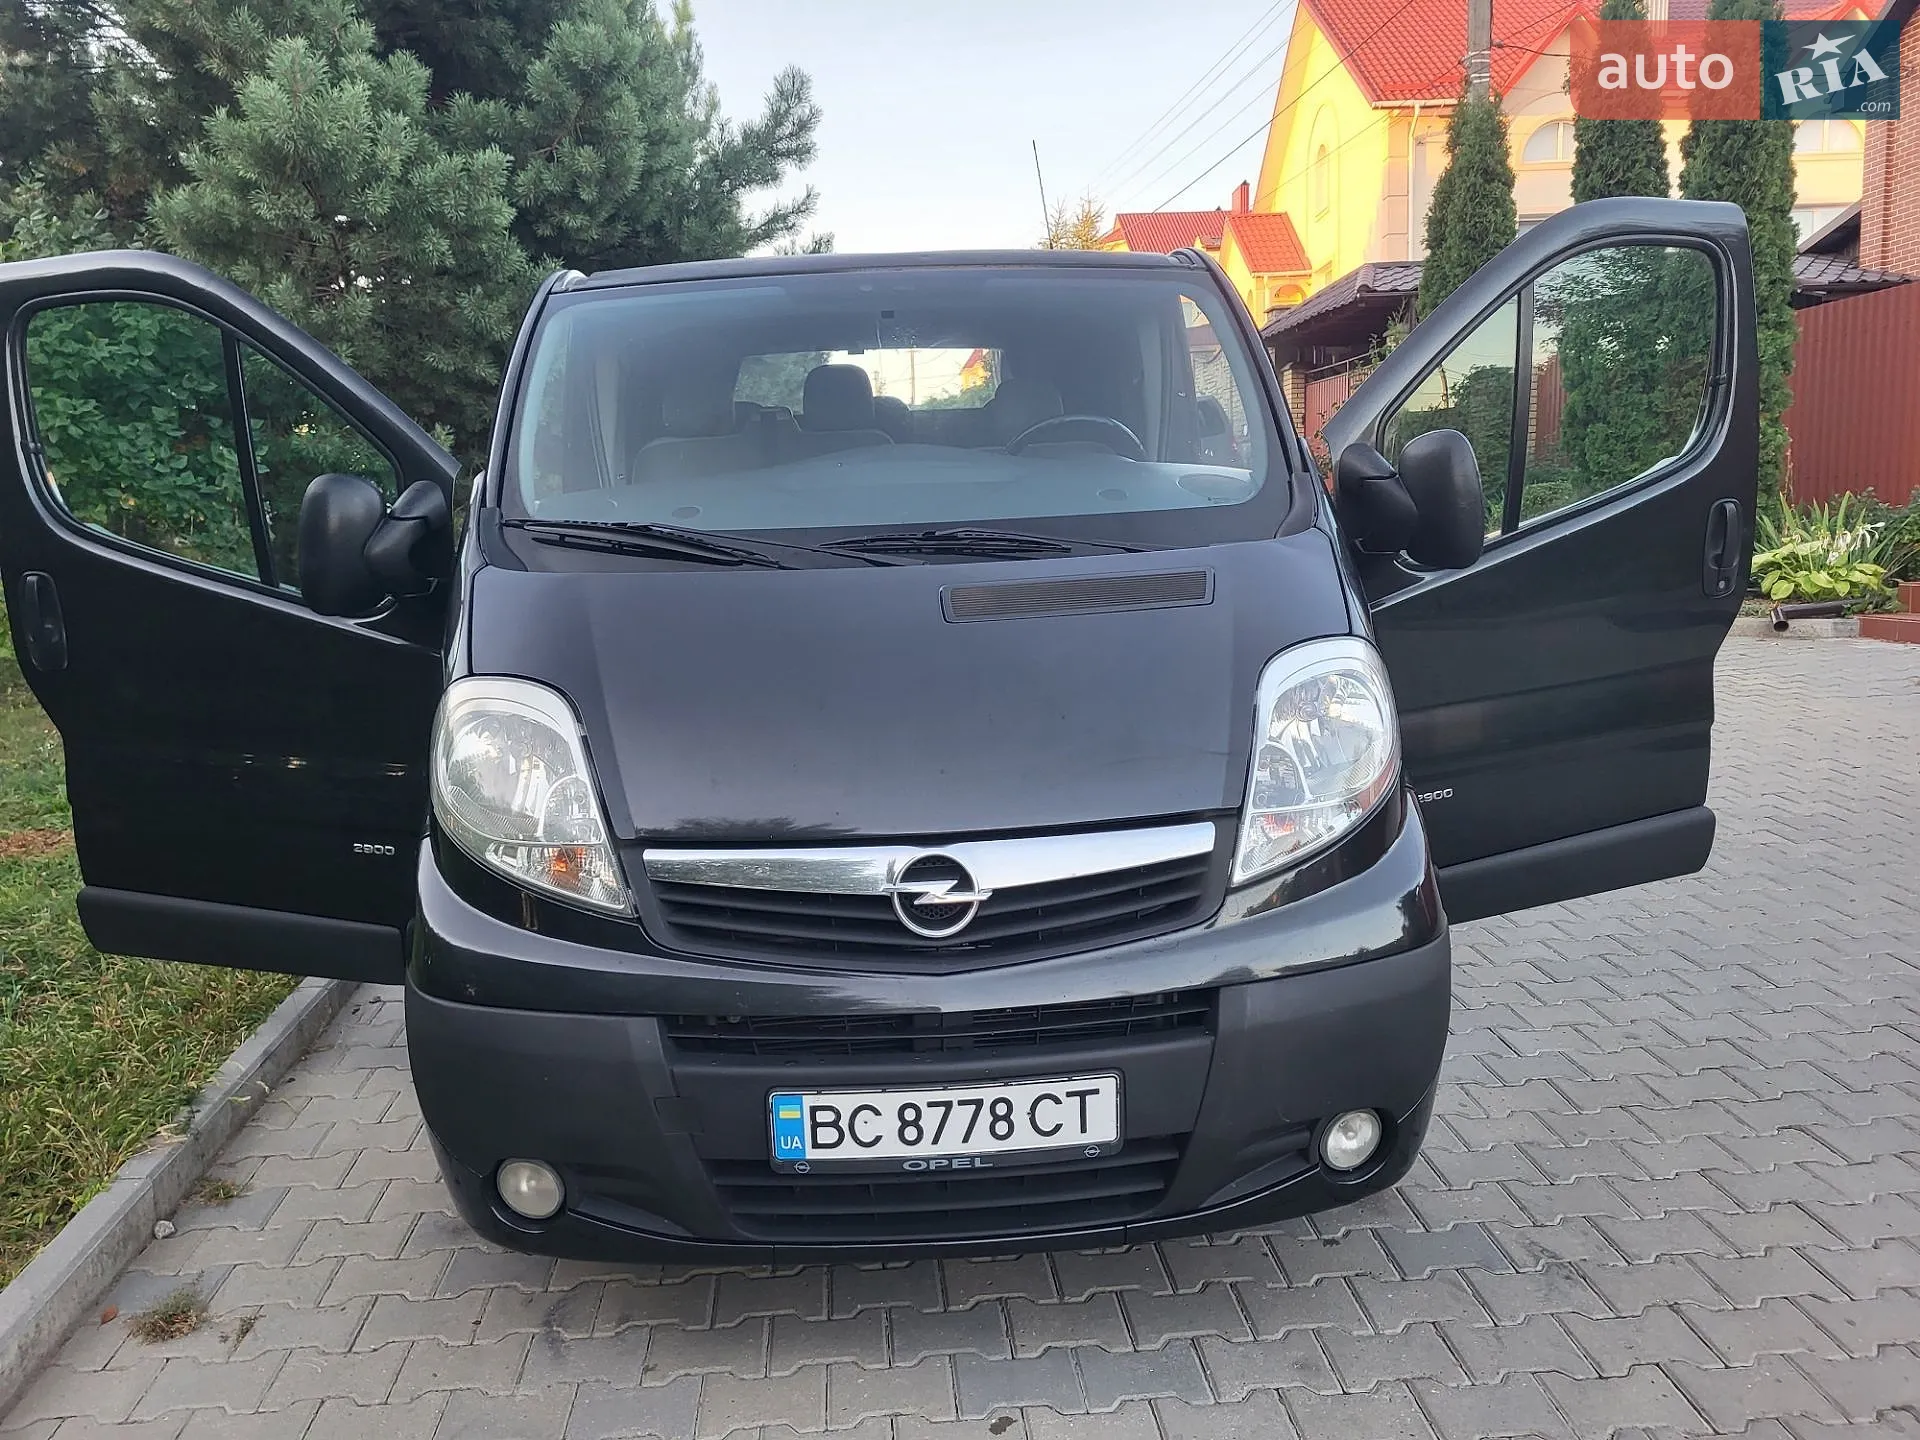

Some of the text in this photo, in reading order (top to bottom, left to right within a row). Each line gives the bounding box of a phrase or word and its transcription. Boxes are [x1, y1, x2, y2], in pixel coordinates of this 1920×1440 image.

[809, 1088, 1100, 1149] BC 8778 CT
[780, 1136, 802, 1150] UA
[903, 1157, 993, 1171] OPEL
